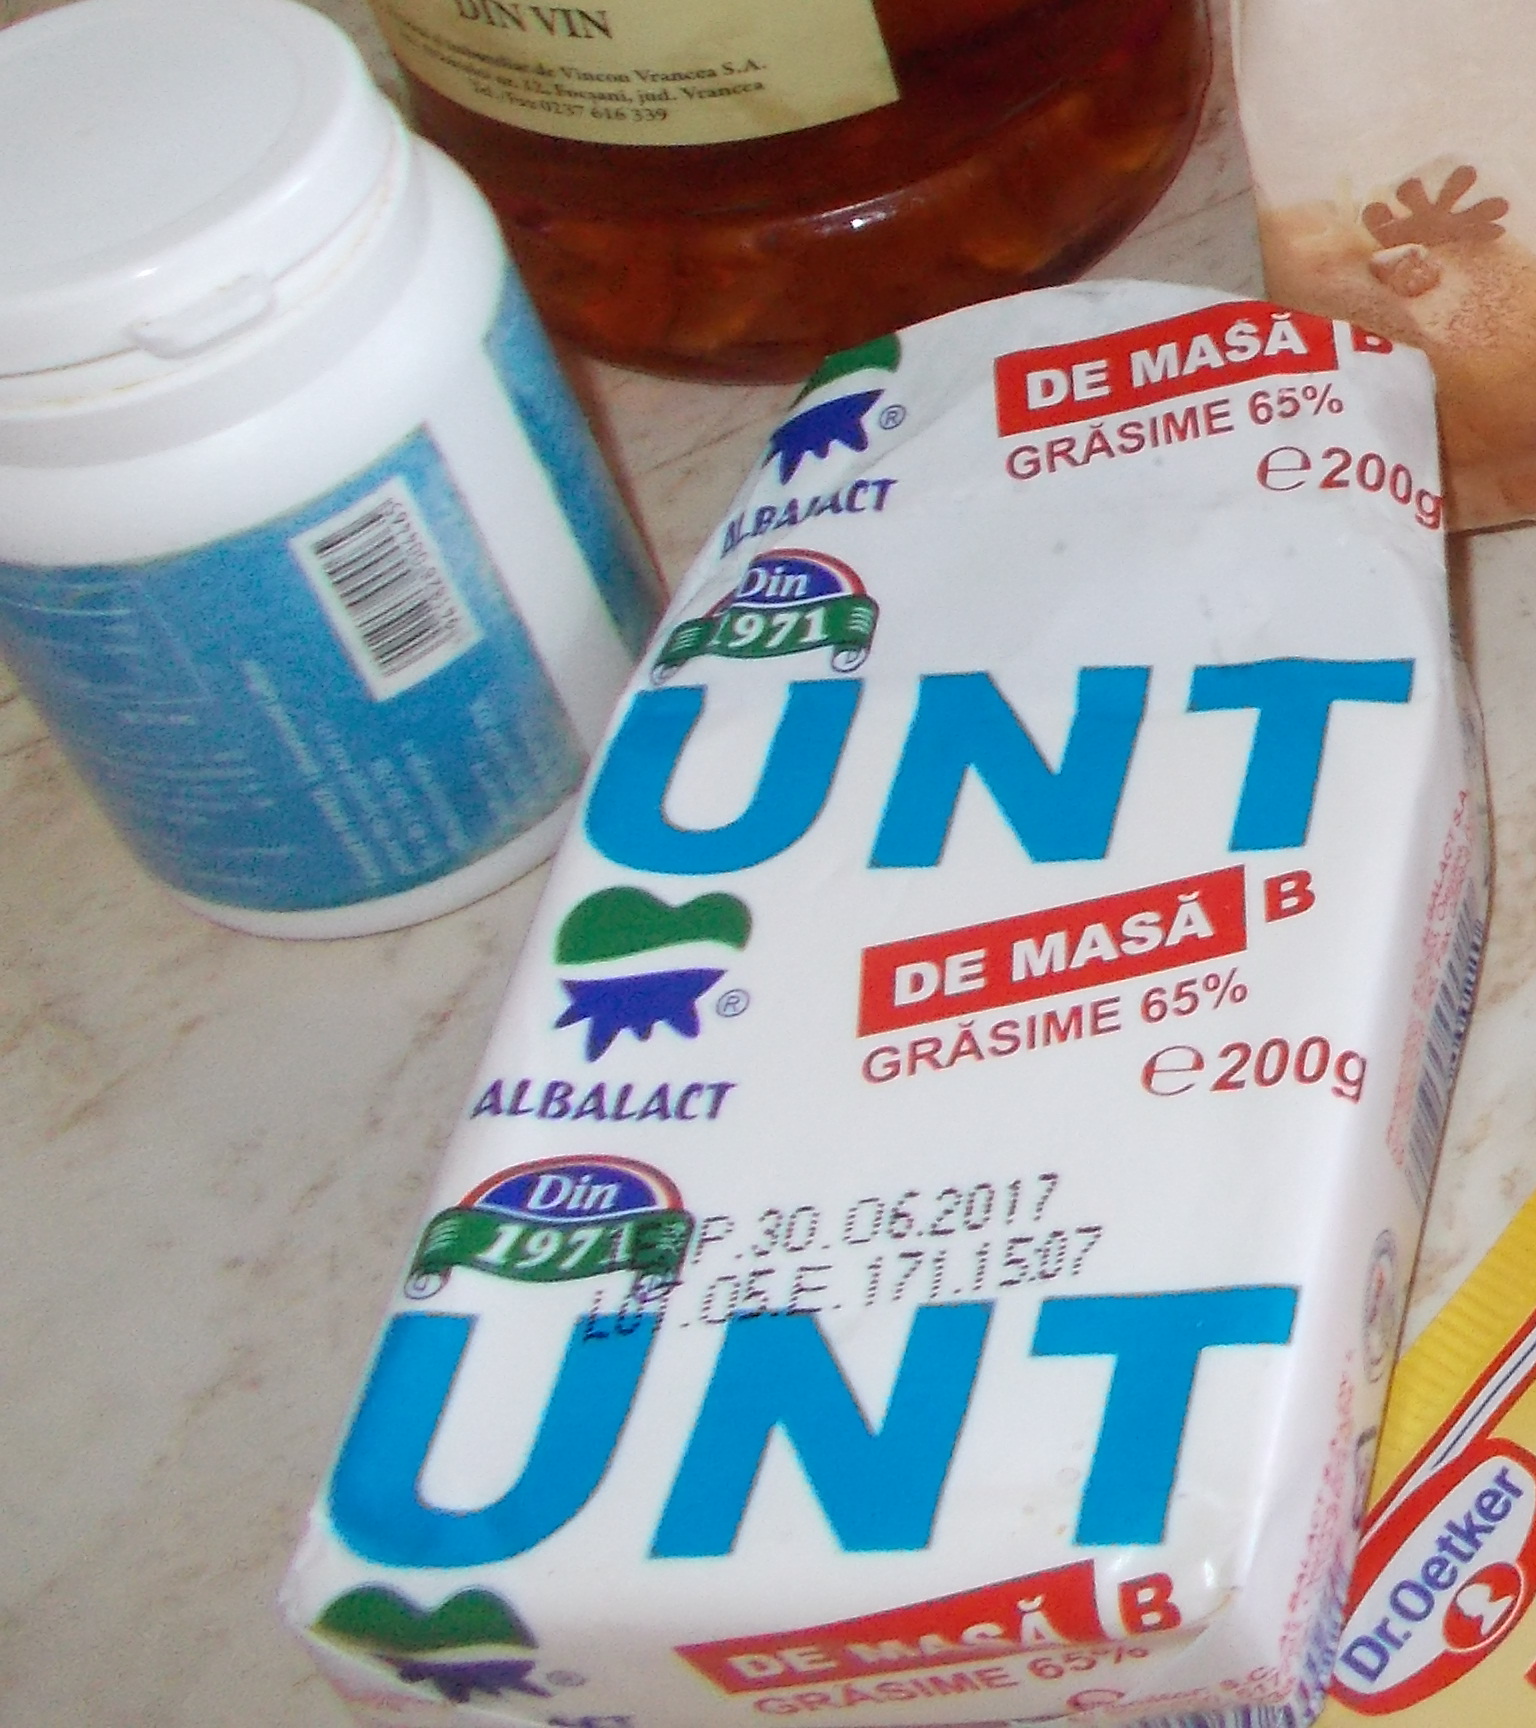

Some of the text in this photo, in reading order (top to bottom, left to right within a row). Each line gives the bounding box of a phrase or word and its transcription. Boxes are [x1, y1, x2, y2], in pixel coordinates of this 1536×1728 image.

[528, 4, 614, 40] VIN
[1026, 358, 1112, 412] DE
[1130, 313, 1309, 390] MASĂ
[1004, 383, 1346, 482] GRĂSIME 65%
[1318, 445, 1444, 532] 200g
[735, 562, 810, 599] Din
[707, 605, 831, 650] 1971
[582, 656, 1418, 877] UNT
[891, 868, 1317, 1008] DE MASĂ B
[859, 966, 1250, 1087] GRĂSIME 65%
[1209, 1034, 1369, 1106] 200g
[469, 1077, 740, 1122] ALBALACT
[525, 1173, 622, 1212] Din
[473, 1221, 634, 1271] 1971
[328, 1285, 1302, 1569] UNT
[730, 1644, 838, 1679] DE
[1116, 1571, 1183, 1635] B
